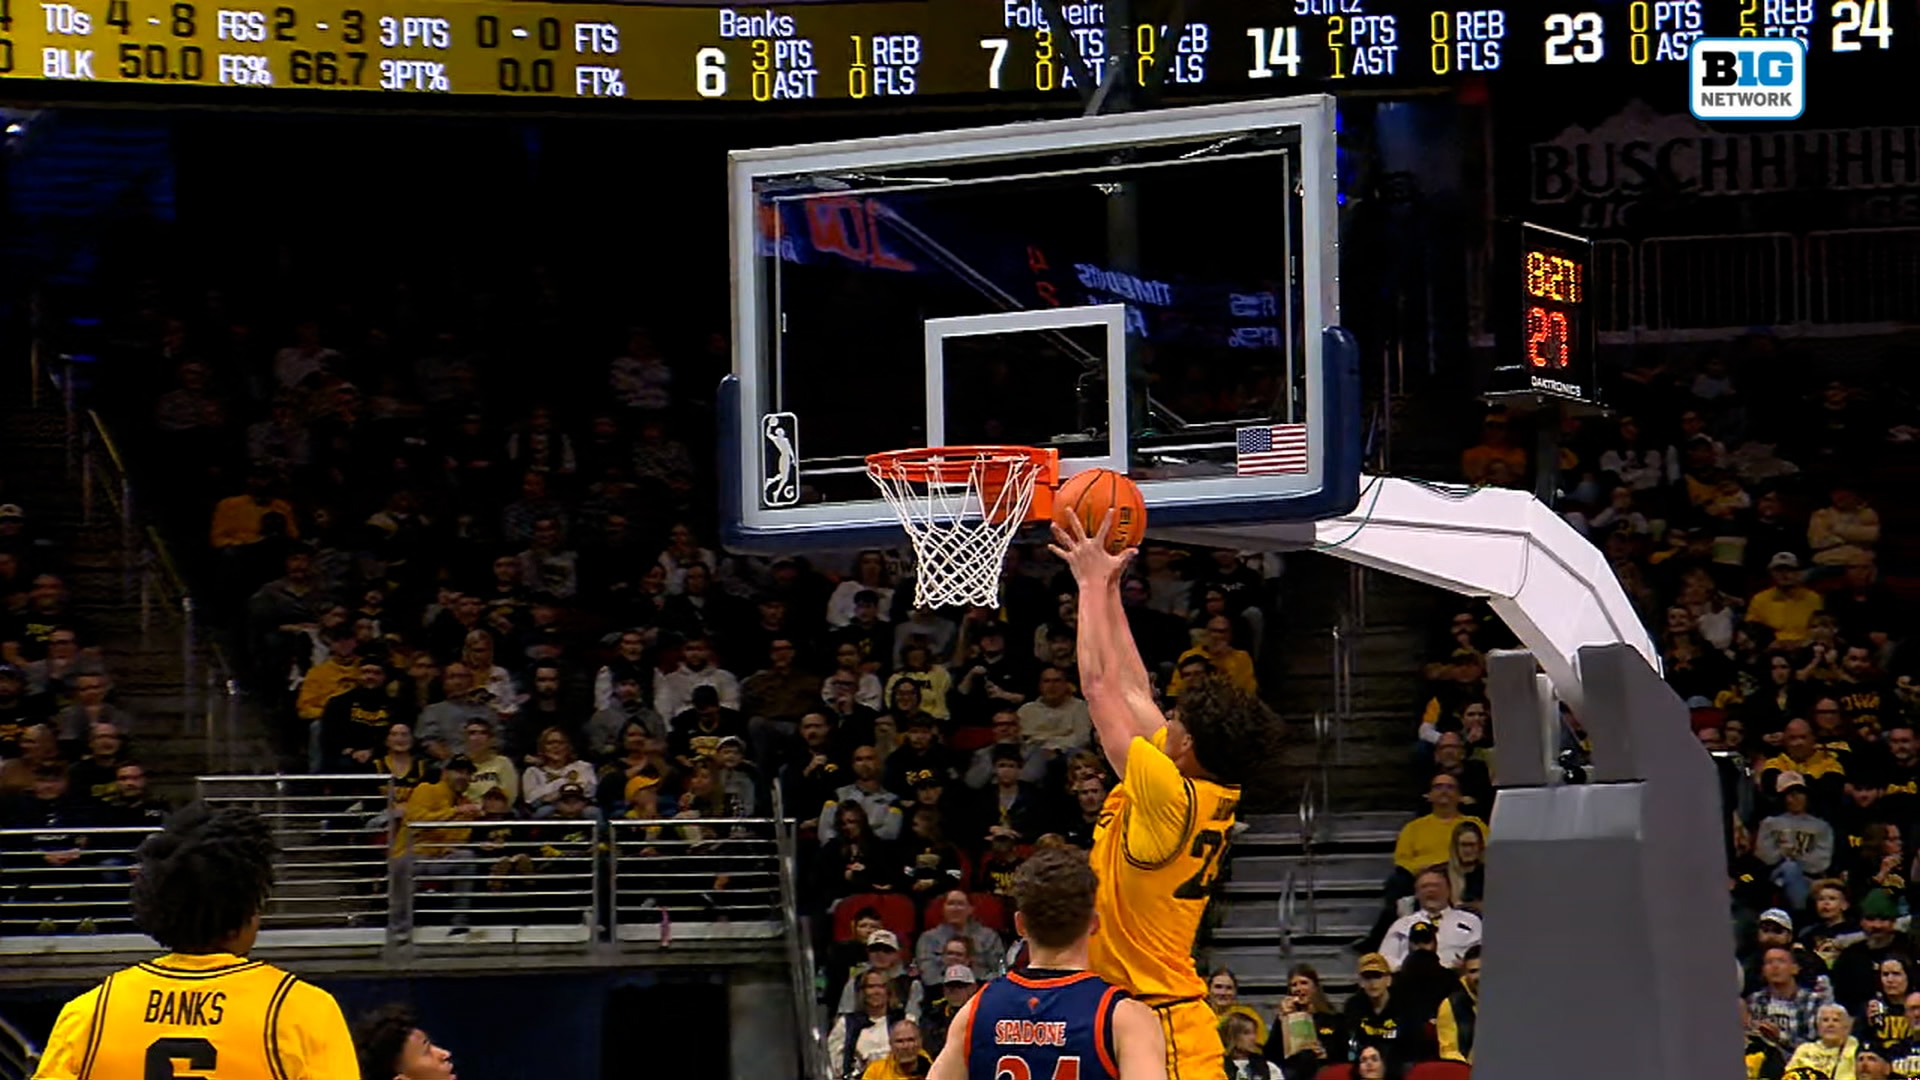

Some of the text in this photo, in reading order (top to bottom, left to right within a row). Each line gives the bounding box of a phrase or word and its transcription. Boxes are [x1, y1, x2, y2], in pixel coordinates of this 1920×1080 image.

[42, 3, 92, 35] TOs
[106, 0, 130, 34] 4
[172, 6, 196, 38] 8
[217, 10, 267, 42] FGS
[275, 7, 297, 41] 2
[342, 10, 365, 44] 3
[379, 17, 397, 47] 3
[402, 18, 449, 48] PTS
[477, 16, 498, 48] 0
[539, 18, 560, 50] 0
[574, 23, 619, 53] FTS
[719, 9, 794, 37] Banks
[1430, 10, 1504, 42] 0 REB
[1630, 1, 1702, 33] 0 PTS
[1740, 0, 1813, 27] 2 REB
[1832, 0, 1893, 52] 24
[1035, 28, 1104, 60] 3 TS
[1137, 23, 1209, 54] 0 EB
[1328, 15, 1395, 46] 2 PTS
[1544, 12, 1603, 65] 23
[752, 39, 812, 71] 3 PTS
[850, 35, 920, 67] 1 REB
[980, 38, 1008, 89] 7
[1247, 26, 1299, 78] 14
[1330, 46, 1398, 78] 1 AST
[1432, 41, 1500, 75] 0 FLS
[1631, 34, 1648, 65] 0
[42, 48, 94, 79] BLK
[119, 44, 203, 80] 50.0
[218, 54, 272, 85] FG%
[288, 50, 368, 86] 66.7
[379, 59, 449, 91] 3PT%
[500, 57, 554, 92] 0.0
[575, 65, 625, 97] FT%
[696, 47, 726, 97] 6
[849, 66, 915, 98] 0 FLS
[1036, 57, 1105, 91] 0 AT
[1164, 53, 1203, 84] LS
[752, 70, 817, 101] 0 AST
[1528, 307, 1568, 367] 27
[1531, 376, 1581, 397] DAKTRONICS
[144, 989, 227, 1026] BANKS
[995, 1020, 1067, 1046] SPADONE
